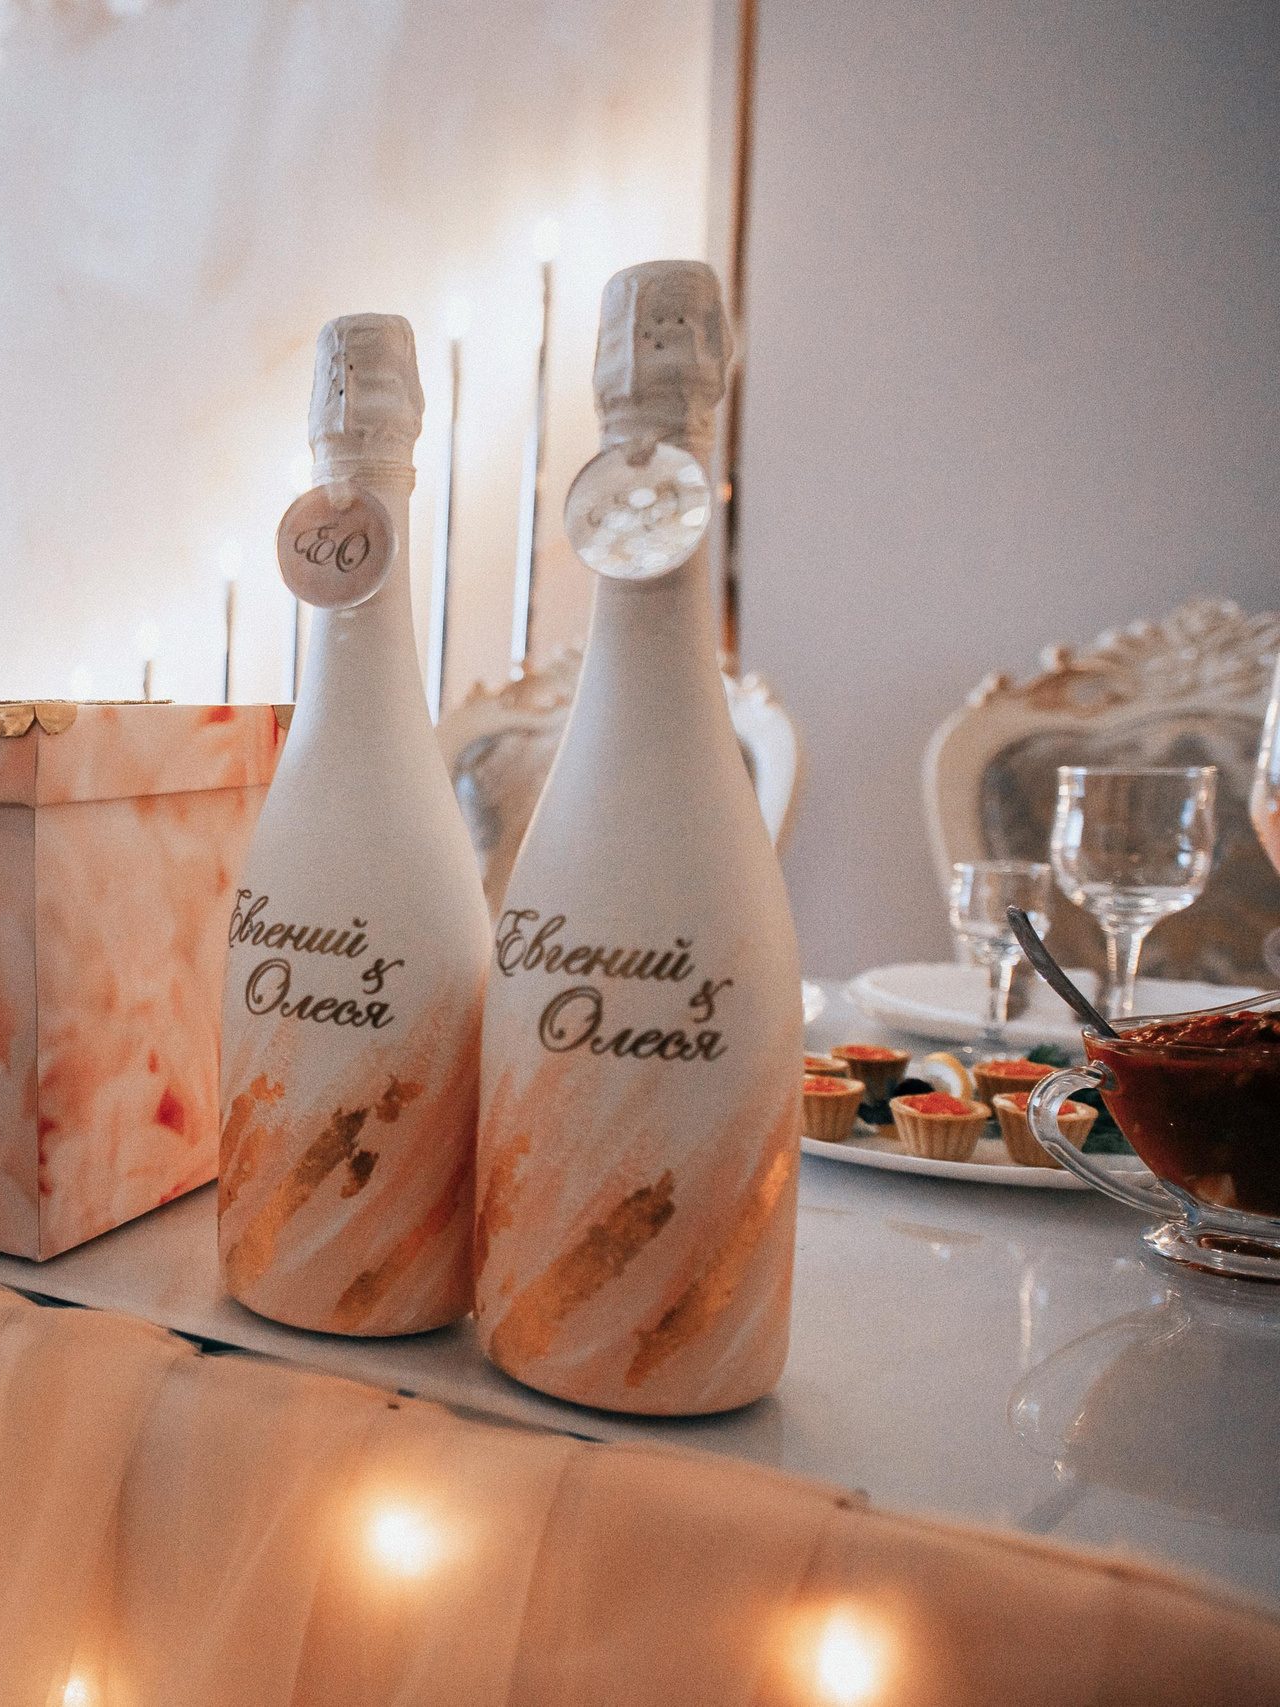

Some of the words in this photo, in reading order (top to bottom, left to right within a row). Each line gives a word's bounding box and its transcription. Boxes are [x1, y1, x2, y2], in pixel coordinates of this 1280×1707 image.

[361, 957, 406, 995] &
[495, 909, 696, 983] Евгений
[245, 957, 396, 1030] Олеся
[538, 985, 729, 1063] Олеся
[688, 977, 734, 1023] &
